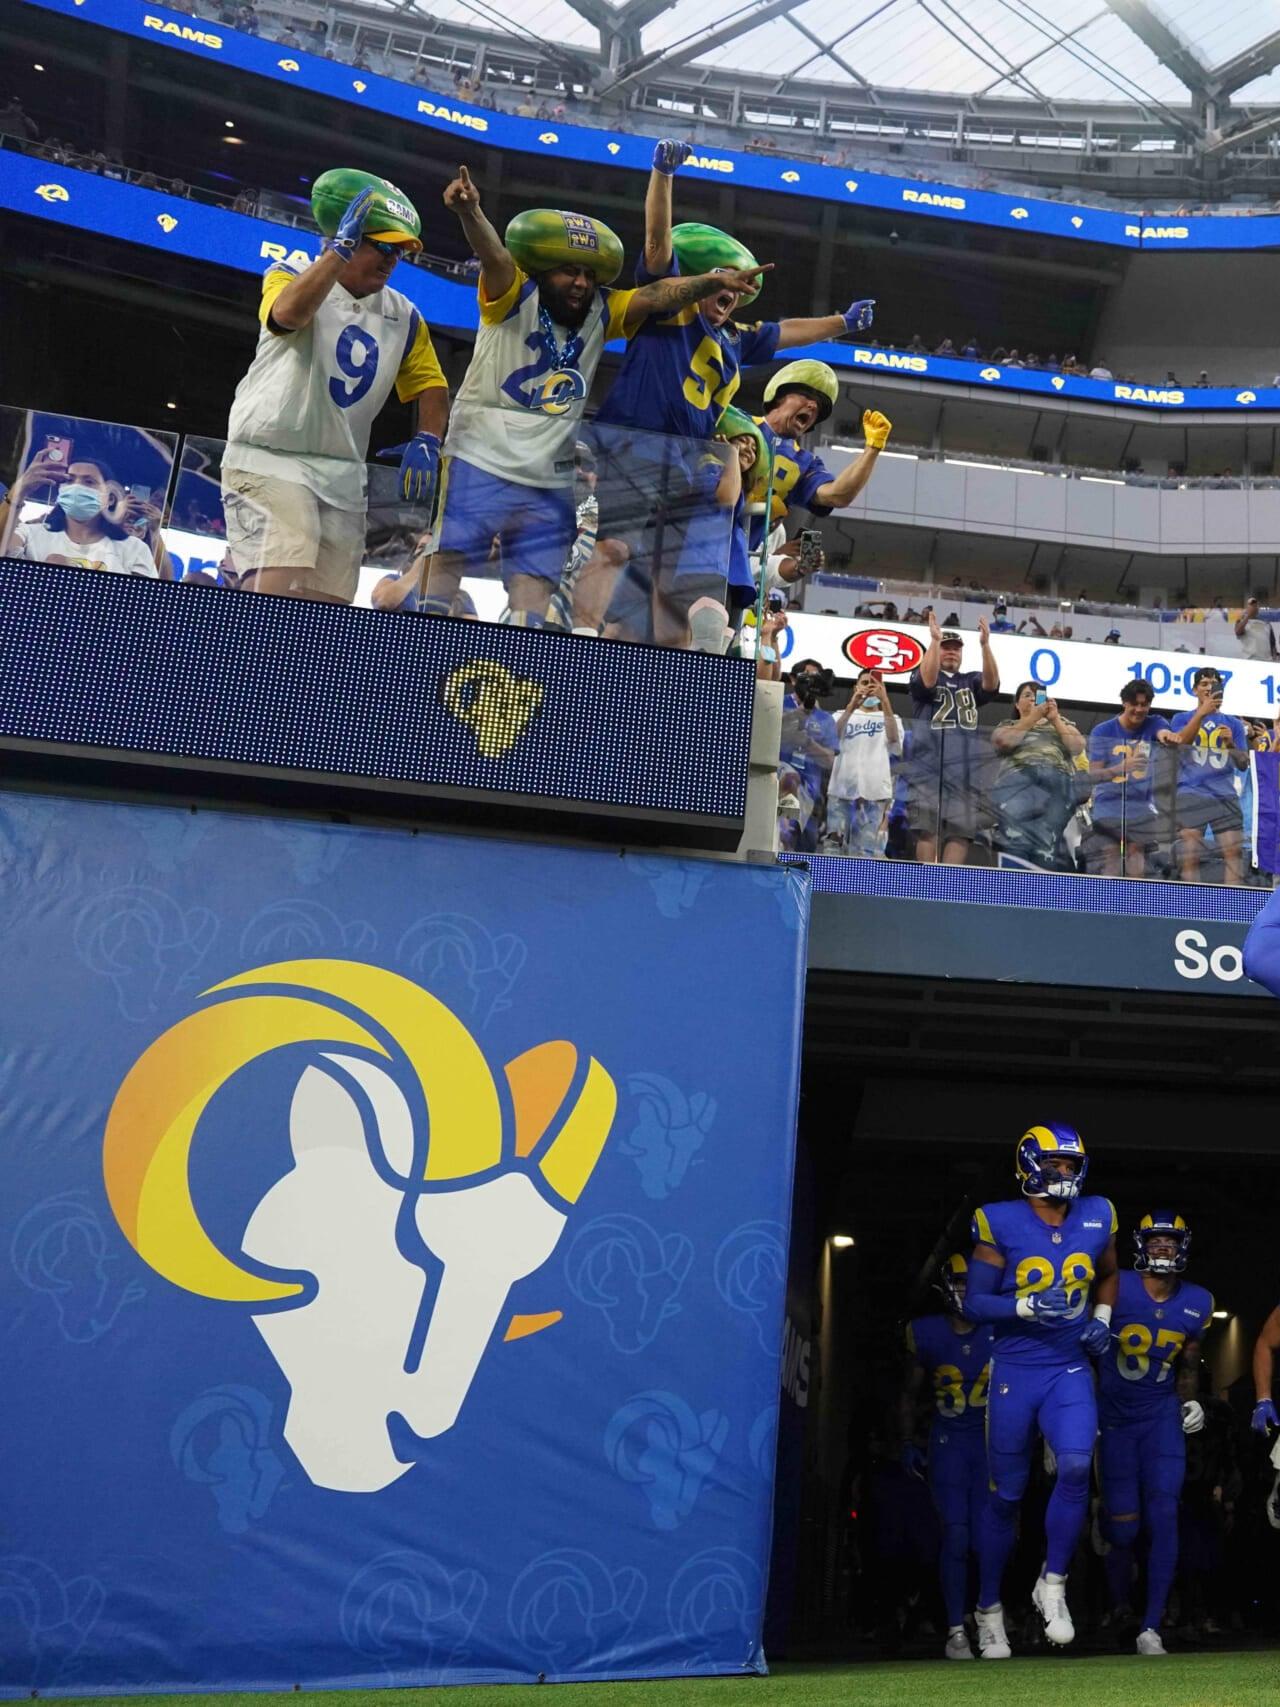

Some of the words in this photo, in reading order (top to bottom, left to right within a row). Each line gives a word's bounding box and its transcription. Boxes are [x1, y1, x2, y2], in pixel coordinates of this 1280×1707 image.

[144, 14, 222, 49] RAMS
[417, 100, 488, 131] RAMS
[683, 155, 734, 173] AMS
[902, 189, 966, 210] RAMS
[1125, 225, 1189, 239] RAMS
[260, 241, 320, 265] RA
[329, 324, 379, 408] 9
[854, 348, 928, 372] RAMS
[1114, 384, 1185, 405] RAMS
[1029, 648, 1062, 687] 0
[932, 686, 979, 731] 28
[1174, 929, 1245, 982] So
[1117, 1323, 1186, 1382] 87
